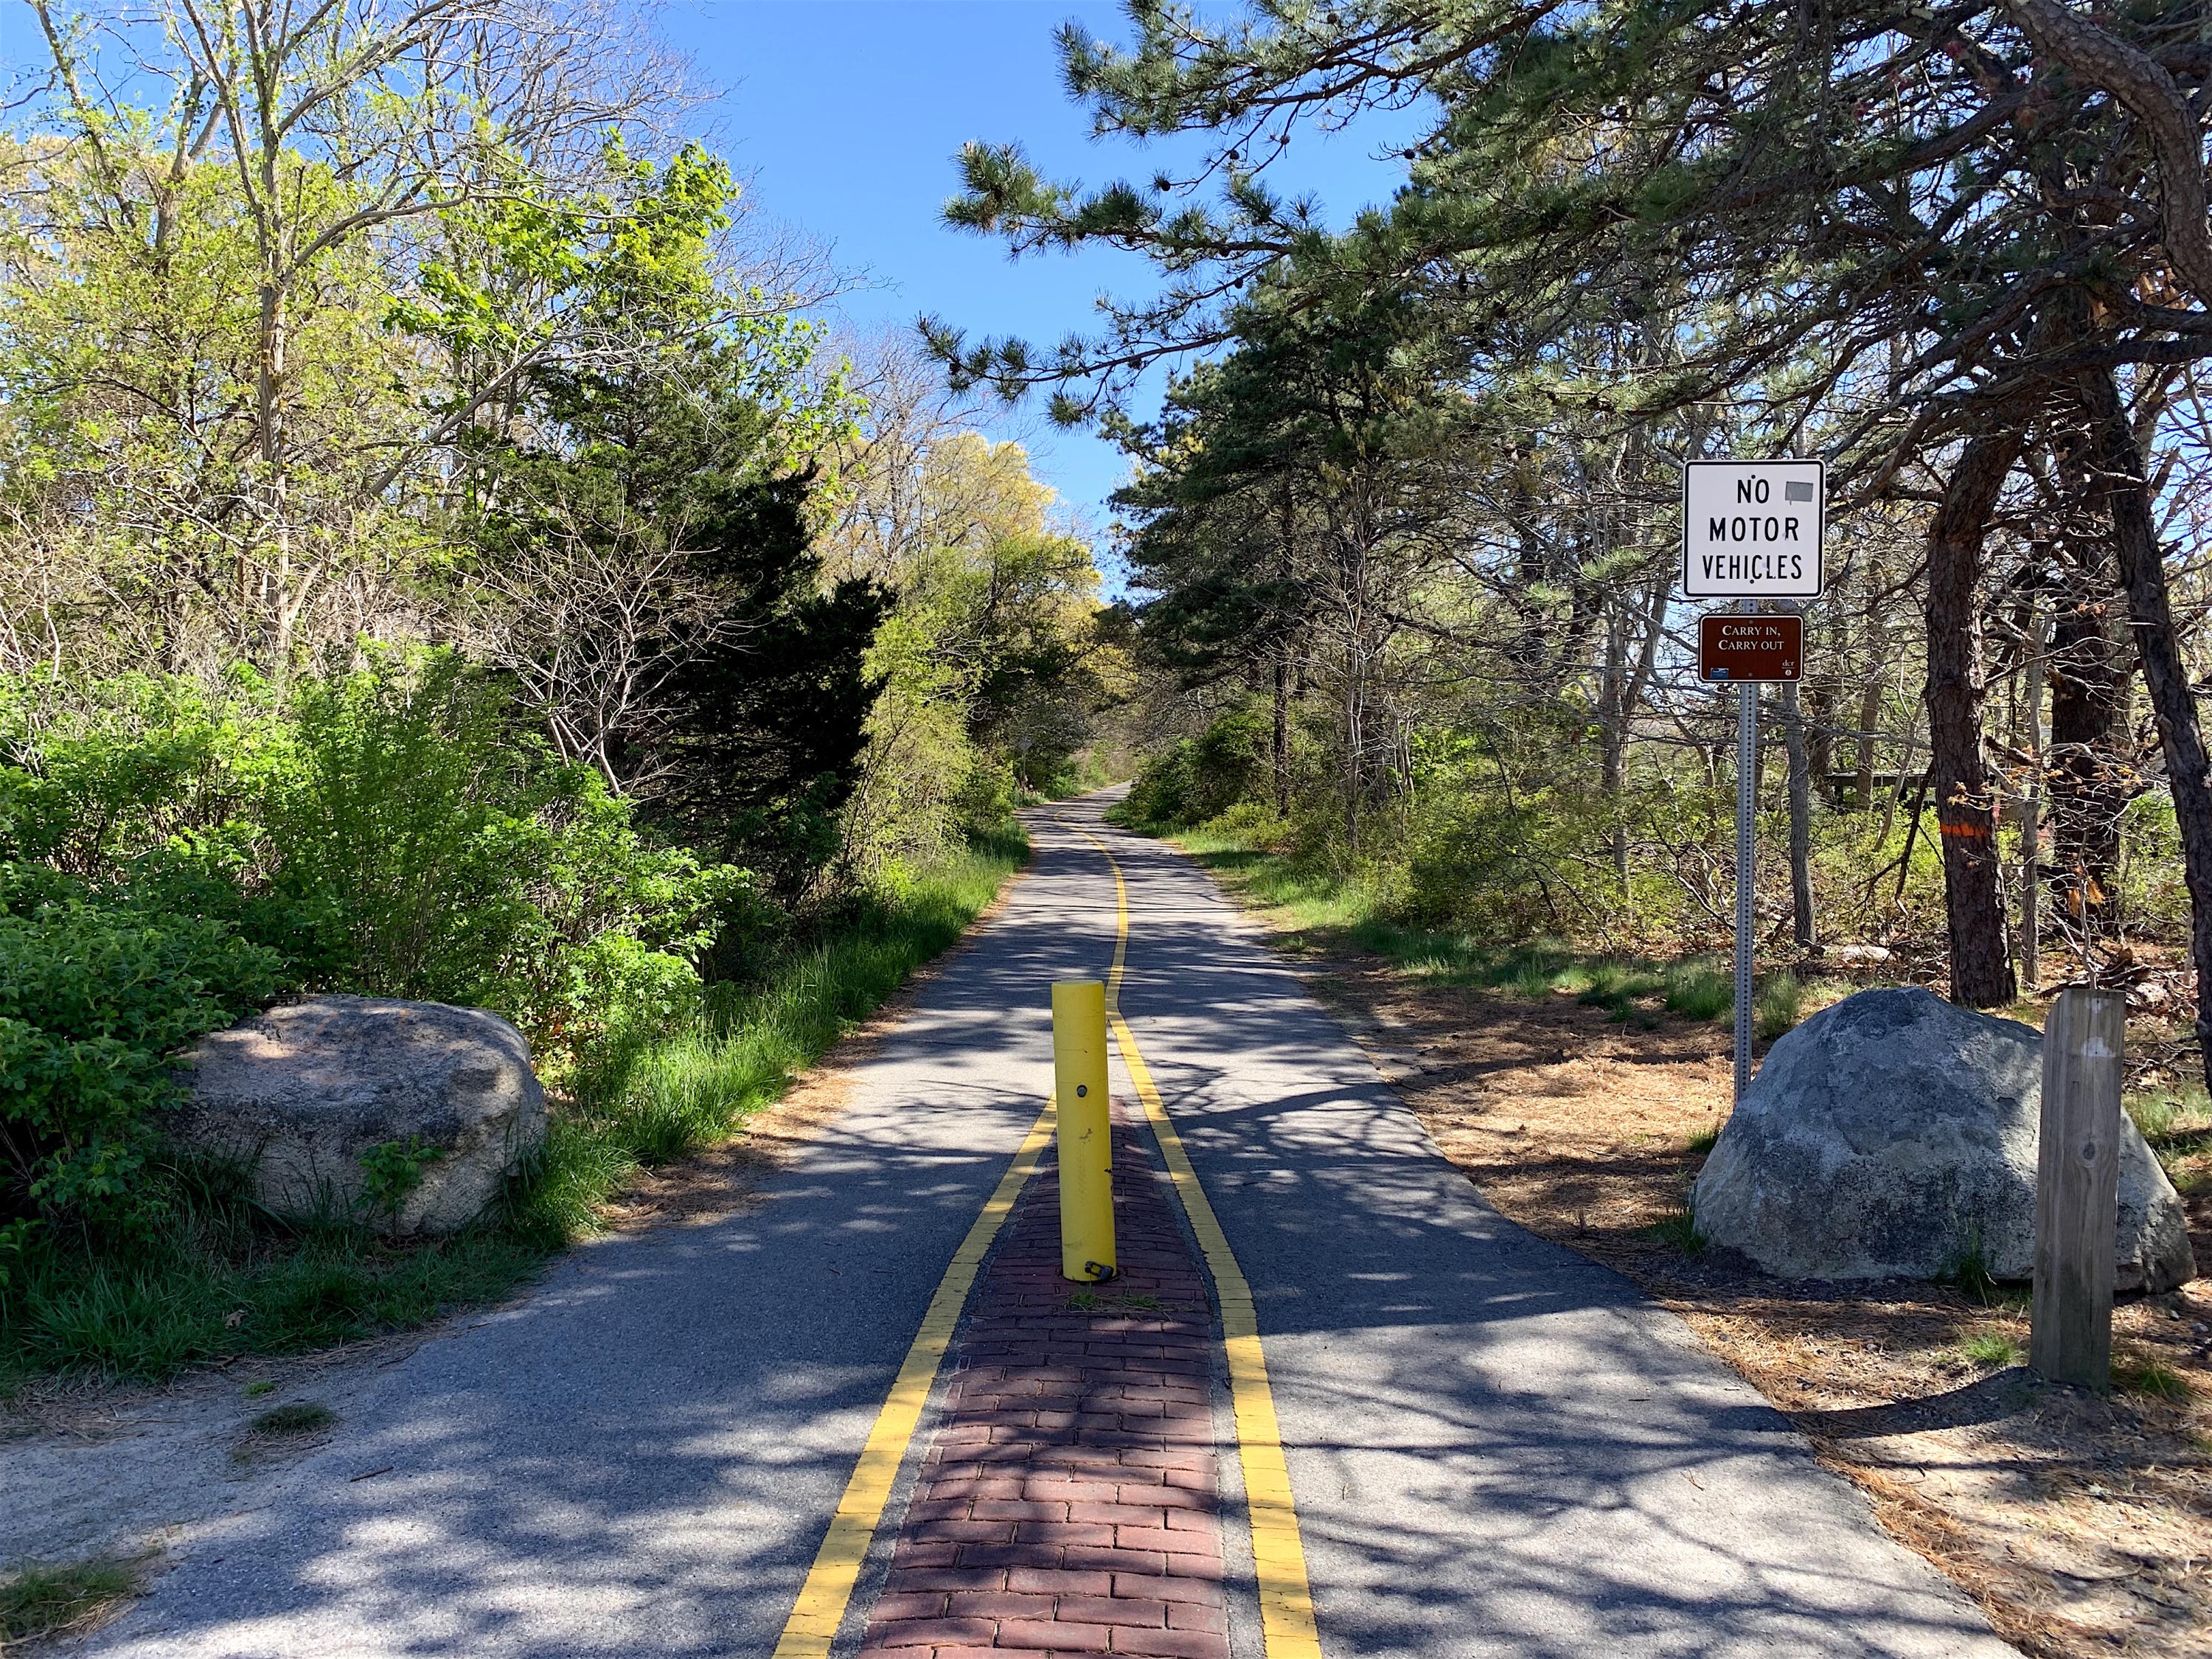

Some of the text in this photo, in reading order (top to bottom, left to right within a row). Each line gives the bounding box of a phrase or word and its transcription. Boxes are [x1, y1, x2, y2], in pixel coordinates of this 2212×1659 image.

[1737, 479, 1770, 504] NO
[1709, 517, 1799, 542] MOTOR
[1703, 554, 1802, 580] VEHICLES
[1722, 625, 1762, 636] CARRY
[1718, 639, 1784, 650] CARRY OUT
